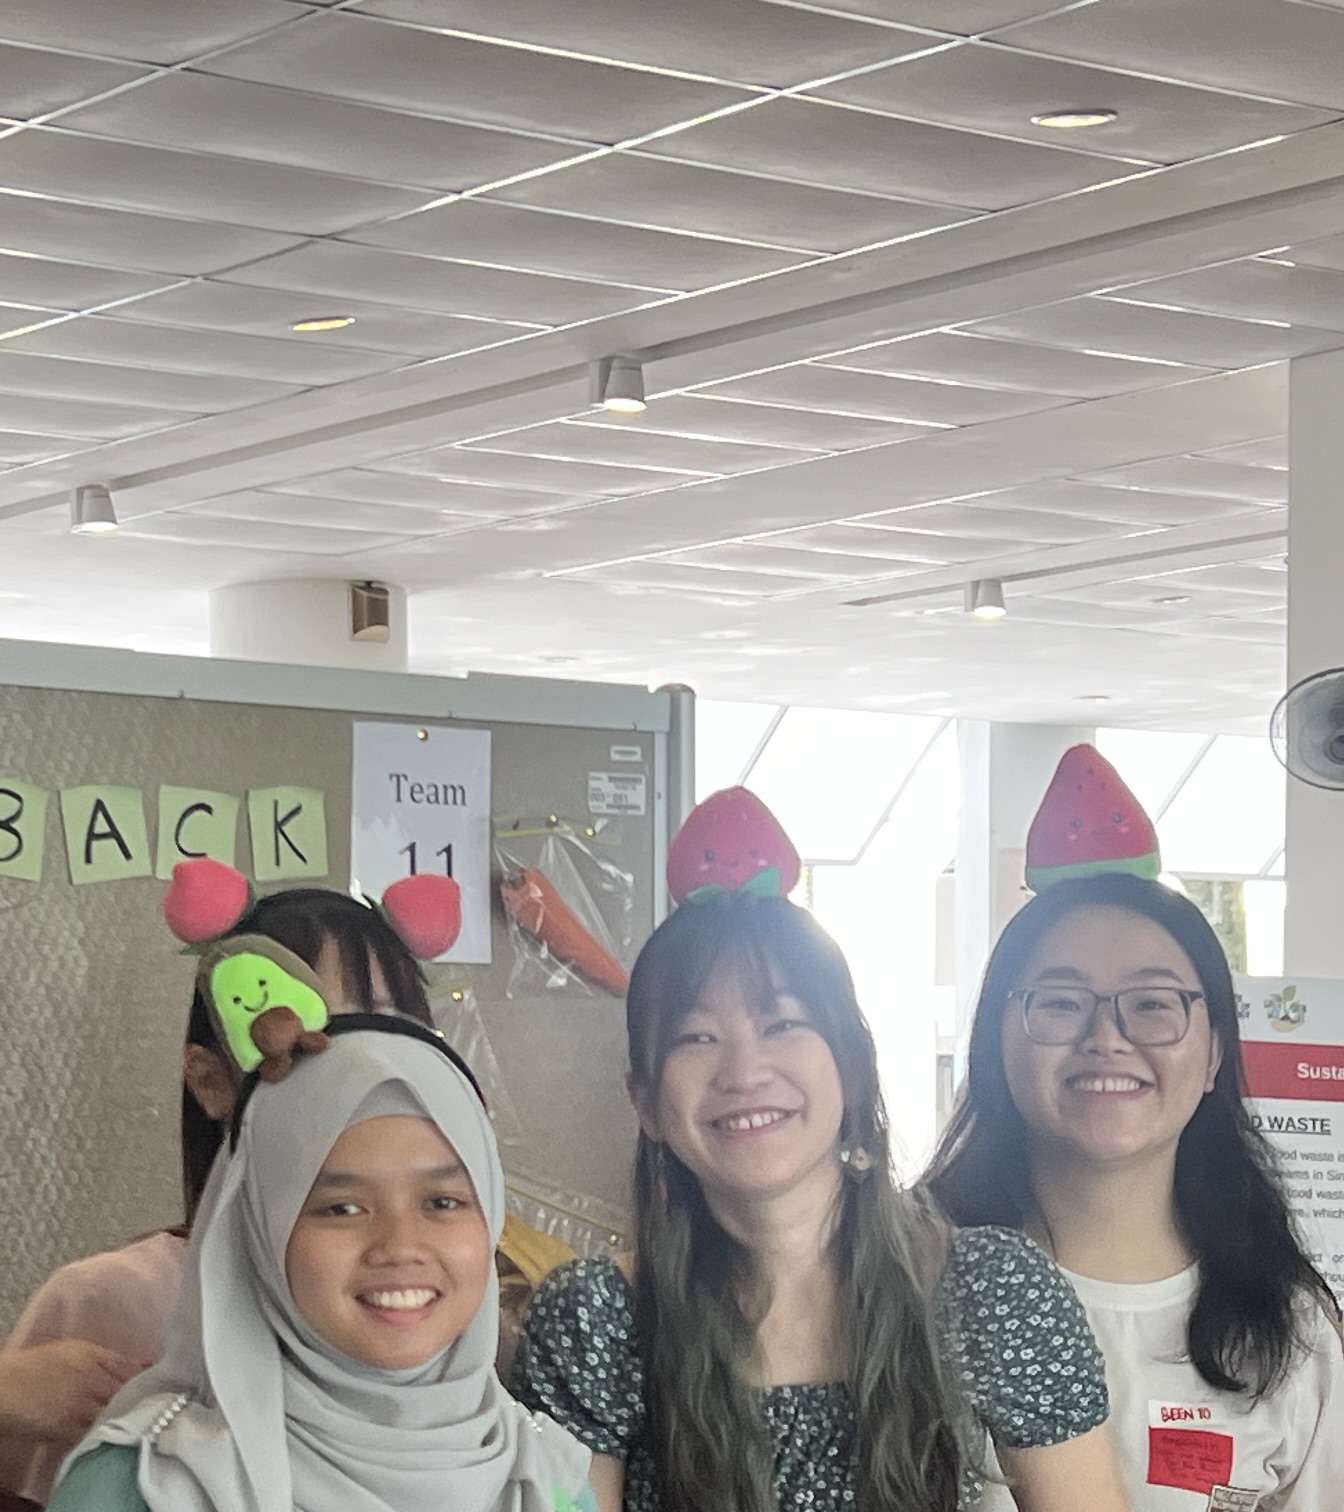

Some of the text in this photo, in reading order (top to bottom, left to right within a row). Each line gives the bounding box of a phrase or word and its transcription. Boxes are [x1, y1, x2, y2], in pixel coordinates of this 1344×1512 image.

[389, 774, 467, 806] Team
[399, 841, 453, 878] 11
[1267, 1116, 1331, 1134] WASTE
[1313, 1170, 1323, 1180] in
